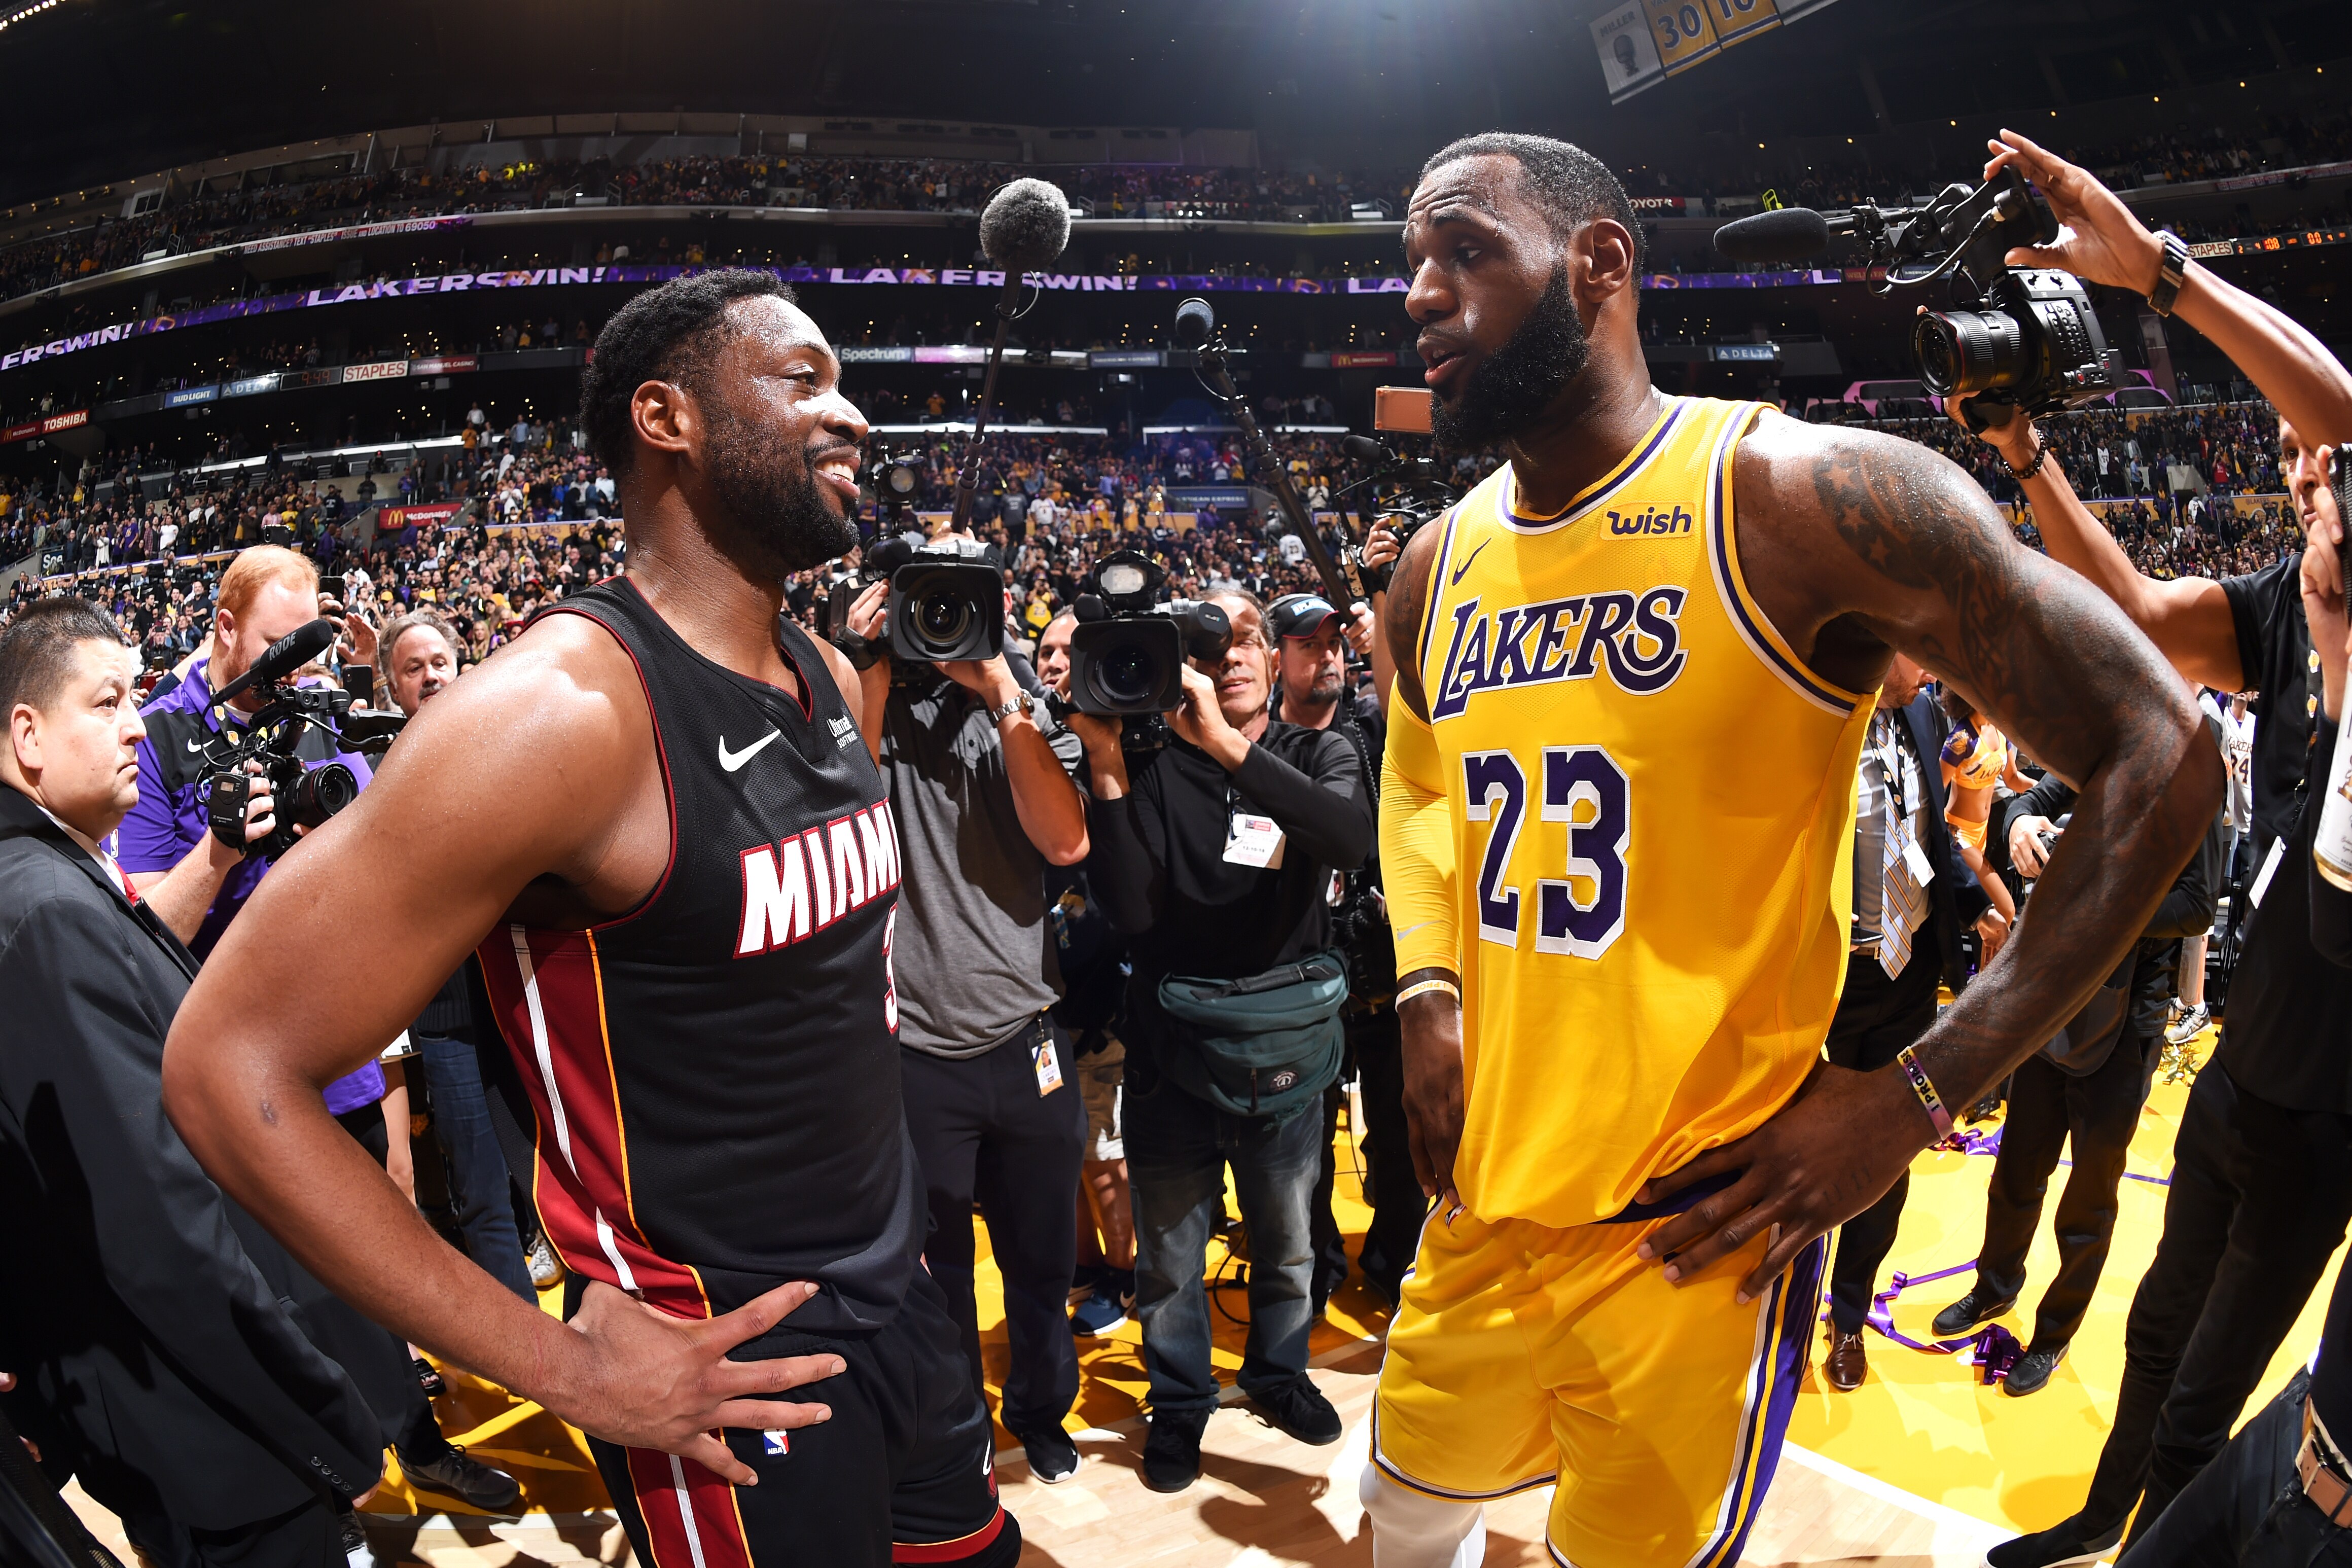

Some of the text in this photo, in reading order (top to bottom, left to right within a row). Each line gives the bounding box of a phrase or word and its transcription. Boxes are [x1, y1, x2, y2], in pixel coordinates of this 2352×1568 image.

[1599, 10, 1635, 38] MILLER
[1657, 4, 1702, 49] 30
[1629, 198, 1673, 208] OYOTA
[243, 244, 257, 254] NEED
[257, 239, 293, 253] ASSISTANCE?
[293, 237, 307, 246] TEXT
[340, 228, 358, 240] ISSUE
[367, 226, 396, 236] LOCATION
[396, 224, 404, 233] TO
[405, 221, 437, 232] 69050
[2264, 237, 2280, 250] 108
[2188, 242, 2231, 257] STAPLES
[841, 348, 905, 362] Spectrum
[1732, 349, 1774, 358] DELTA
[345, 362, 405, 380] STAPLES
[173, 390, 211, 404] BUD LIGHT
[44, 412, 87, 431] TOSHIBA
[406, 510, 451, 521] McDonald's
[1606, 506, 1692, 536] wish
[269, 631, 297, 661] RØDE
[1431, 584, 1690, 725] LAKERS
[2229, 735, 2253, 753] LAKER
[1460, 744, 1631, 961] 23
[1400, 981, 1440, 999] PROMISE
[1900, 1050, 1940, 1112] I PROMISE
[767, 1446, 783, 1455] NBA
